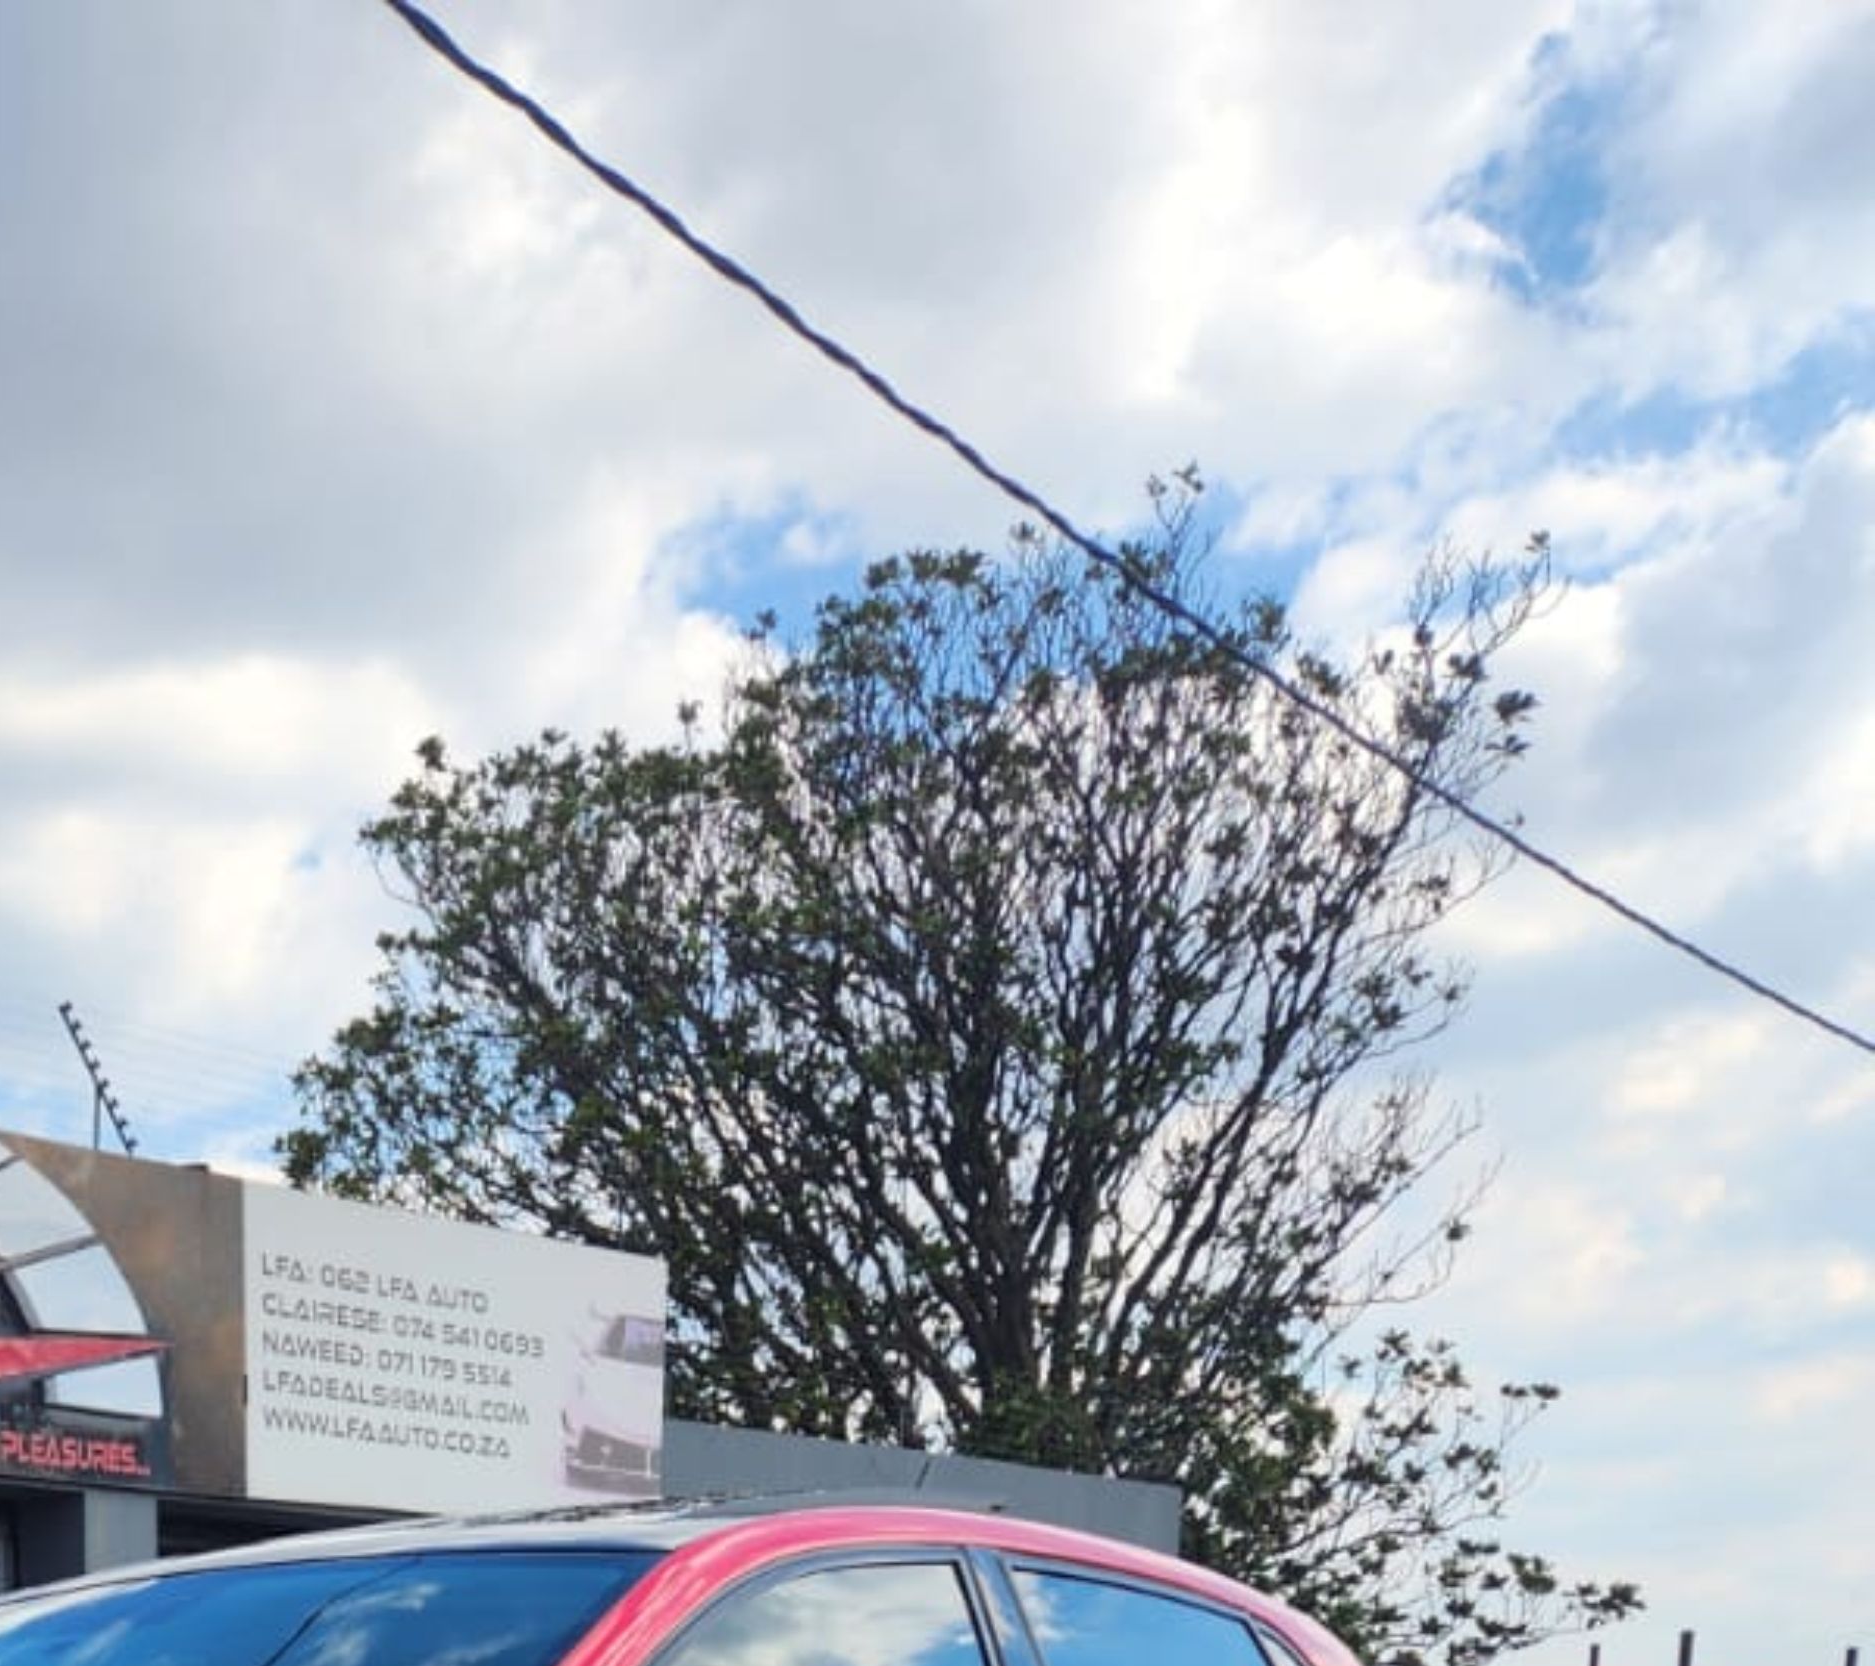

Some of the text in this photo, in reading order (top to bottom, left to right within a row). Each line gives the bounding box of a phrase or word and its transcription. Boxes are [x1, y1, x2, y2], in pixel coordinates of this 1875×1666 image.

[321, 1263, 370, 1295] 062
[377, 1272, 419, 1302] LFA
[428, 1283, 489, 1314] AUTO
[392, 1314, 435, 1340] 074
[262, 1328, 513, 1388] NAWEED: 071 179 5514
[2, 1430, 152, 1478] PLEASURES...
[263, 1405, 512, 1459] WWW.LFAAUTO.CO.ZA
